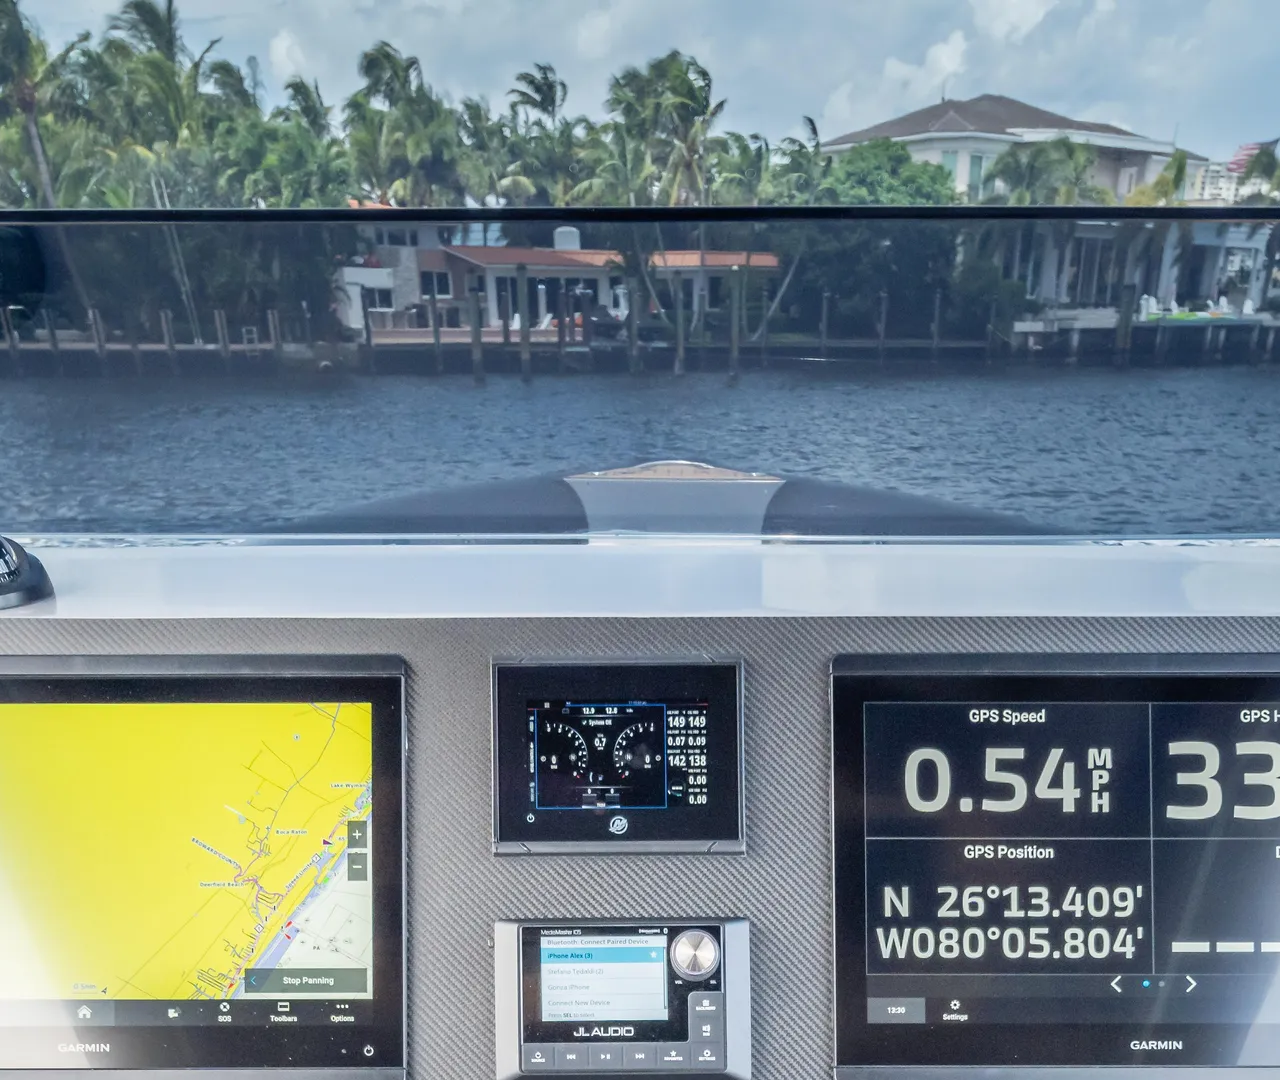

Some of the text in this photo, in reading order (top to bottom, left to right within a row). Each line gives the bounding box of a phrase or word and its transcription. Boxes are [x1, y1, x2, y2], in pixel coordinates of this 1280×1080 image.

[969, 709, 1046, 725] GPS Speed
[1240, 709, 1270, 723] GPS
[667, 716, 706, 727] 149 149
[594, 738, 606, 747] 0.7
[667, 736, 706, 746] 0.07 0.09
[668, 755, 707, 767] 142 138
[688, 775, 707, 785] 0.00
[904, 747, 1081, 813] 0.54
[688, 794, 707, 804] 0.00
[963, 845, 1055, 859] GPS Position
[884, 886, 909, 917] N
[584, 952, 593, 960] (3)
[283, 976, 335, 986] Stop Panning
[330, 1015, 355, 1023] Options
[942, 1012, 968, 1021] Settings
[573, 1026, 634, 1036] JL AUDIO
[57, 1043, 111, 1053] GARMIN
[1130, 1040, 1183, 1050] GARMIN
